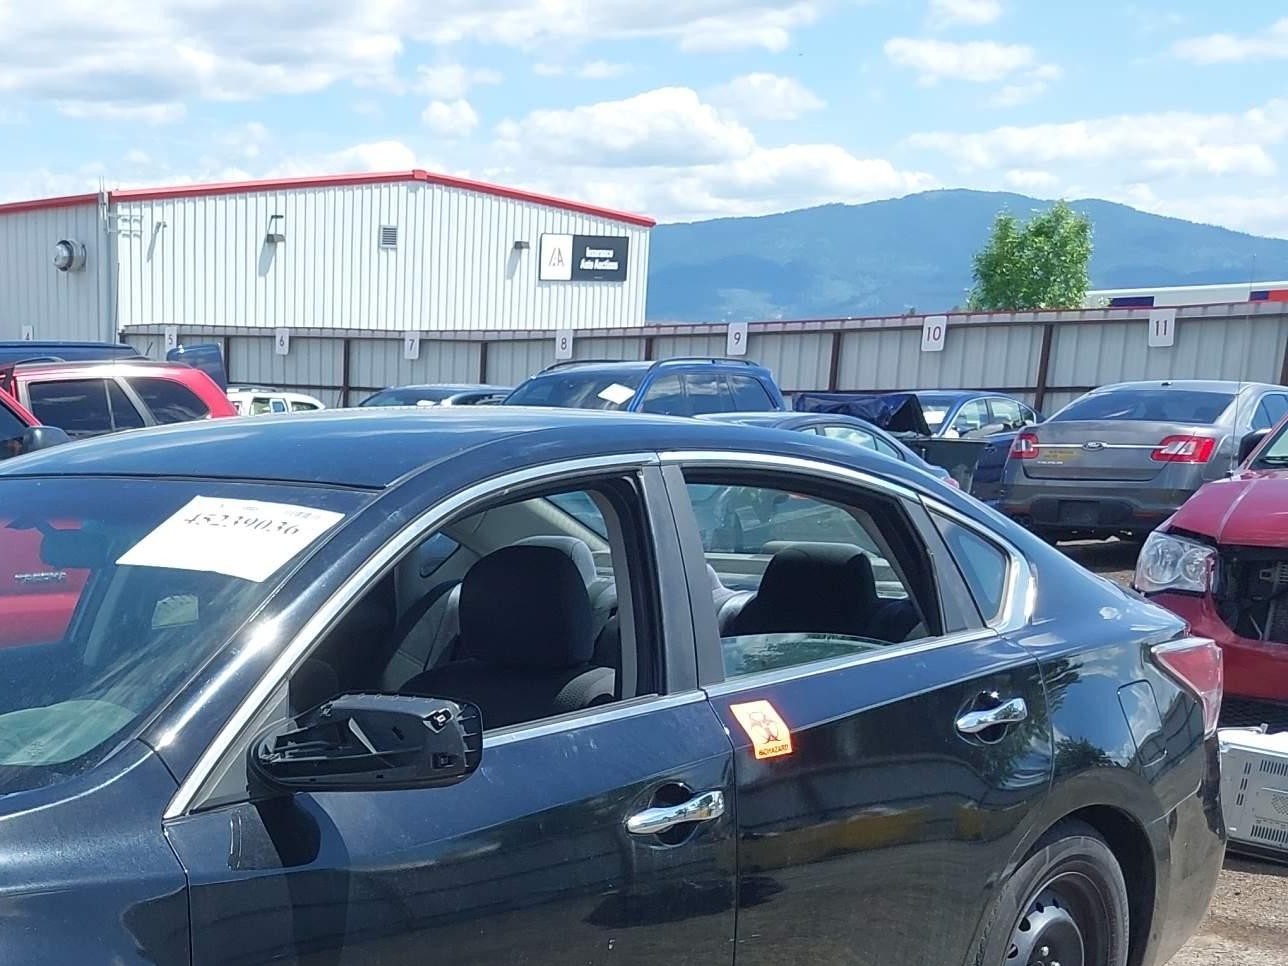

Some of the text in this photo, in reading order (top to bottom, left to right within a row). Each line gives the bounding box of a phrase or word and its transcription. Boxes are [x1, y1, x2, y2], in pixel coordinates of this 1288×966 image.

[926, 326, 942, 342] 10
[1153, 319, 1168, 337] 11
[168, 334, 173, 345] 5
[279, 336, 285, 346] 6
[408, 338, 415, 351] 7
[560, 337, 567, 351] 8
[733, 331, 741, 345] 9
[183, 513, 300, 535] 45239036
